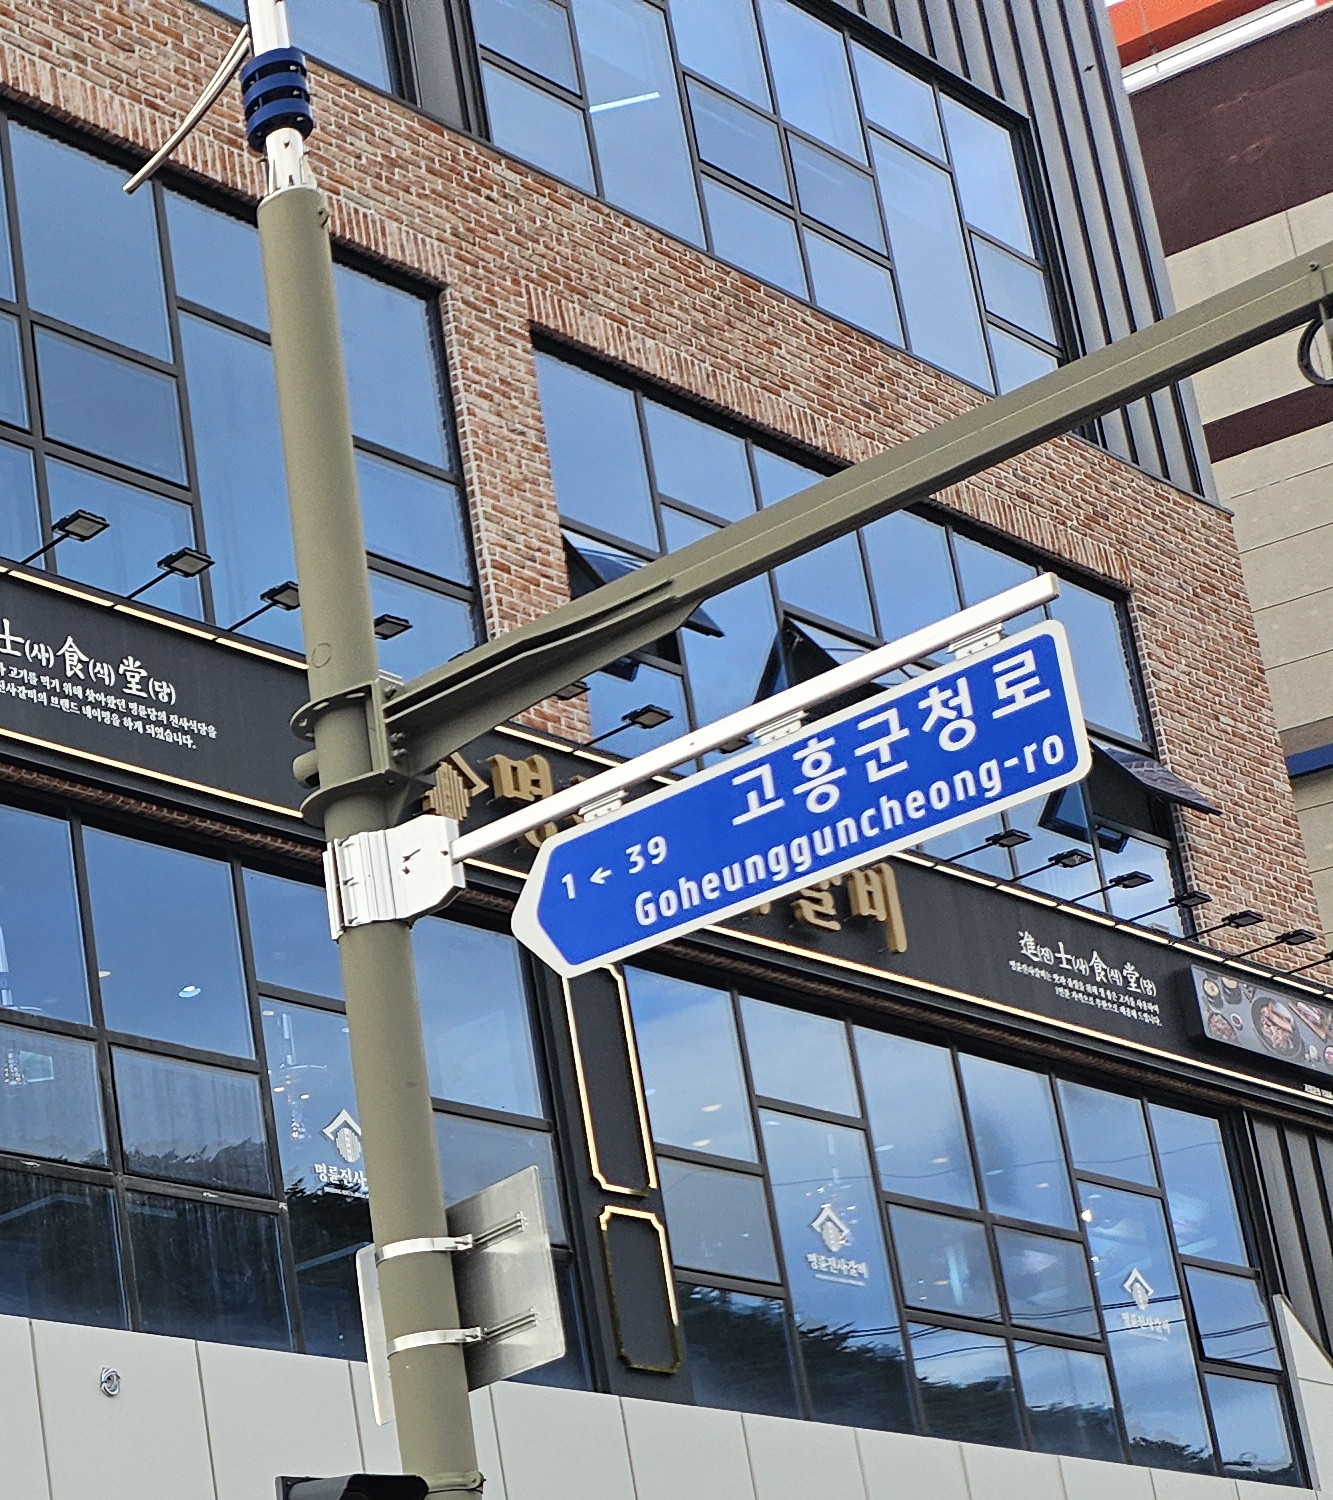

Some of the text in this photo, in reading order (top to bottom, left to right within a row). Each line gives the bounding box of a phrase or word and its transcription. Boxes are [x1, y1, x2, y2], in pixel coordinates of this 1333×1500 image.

[8, 666, 38, 686] 고기를
[39, 675, 60, 692] 먹기
[62, 682, 83, 700] 위해
[732, 649, 1051, 827] 고흥군청로
[635, 734, 1065, 926] Goheungguncheong-ro
[561, 834, 668, 900] 1 39
[314, 1163, 368, 1190] 명륜진사
